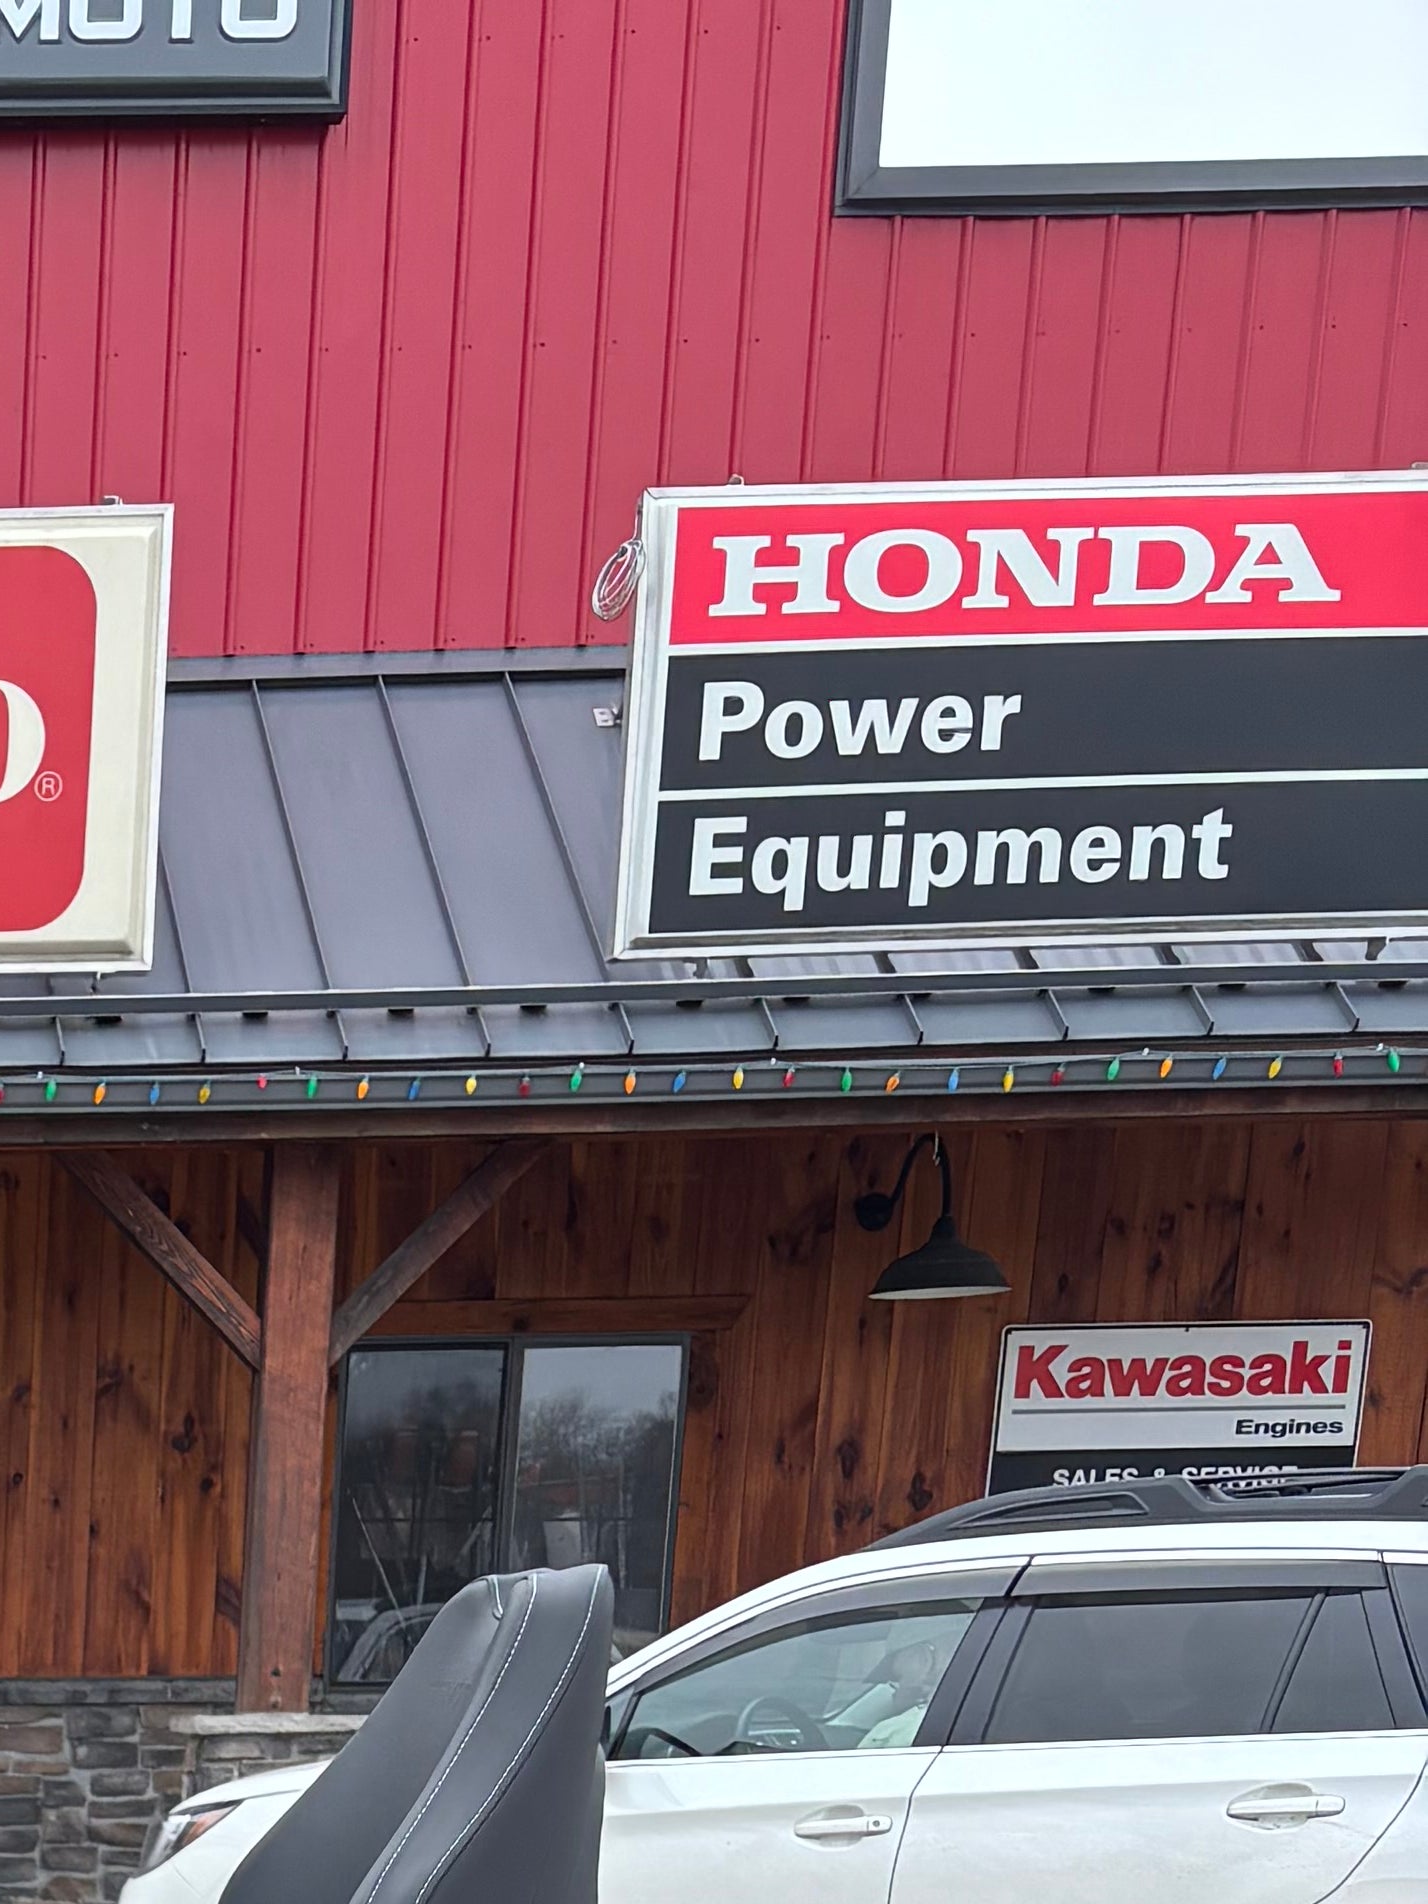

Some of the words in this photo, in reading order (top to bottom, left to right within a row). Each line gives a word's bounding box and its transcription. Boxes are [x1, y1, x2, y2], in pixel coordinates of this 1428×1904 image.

[708, 523, 1342, 618] HONDA
[698, 680, 1023, 762] Power
[688, 807, 1233, 913] Equipment
[1013, 1339, 1353, 1400] Kawasaki
[1235, 1418, 1344, 1439] Engines
